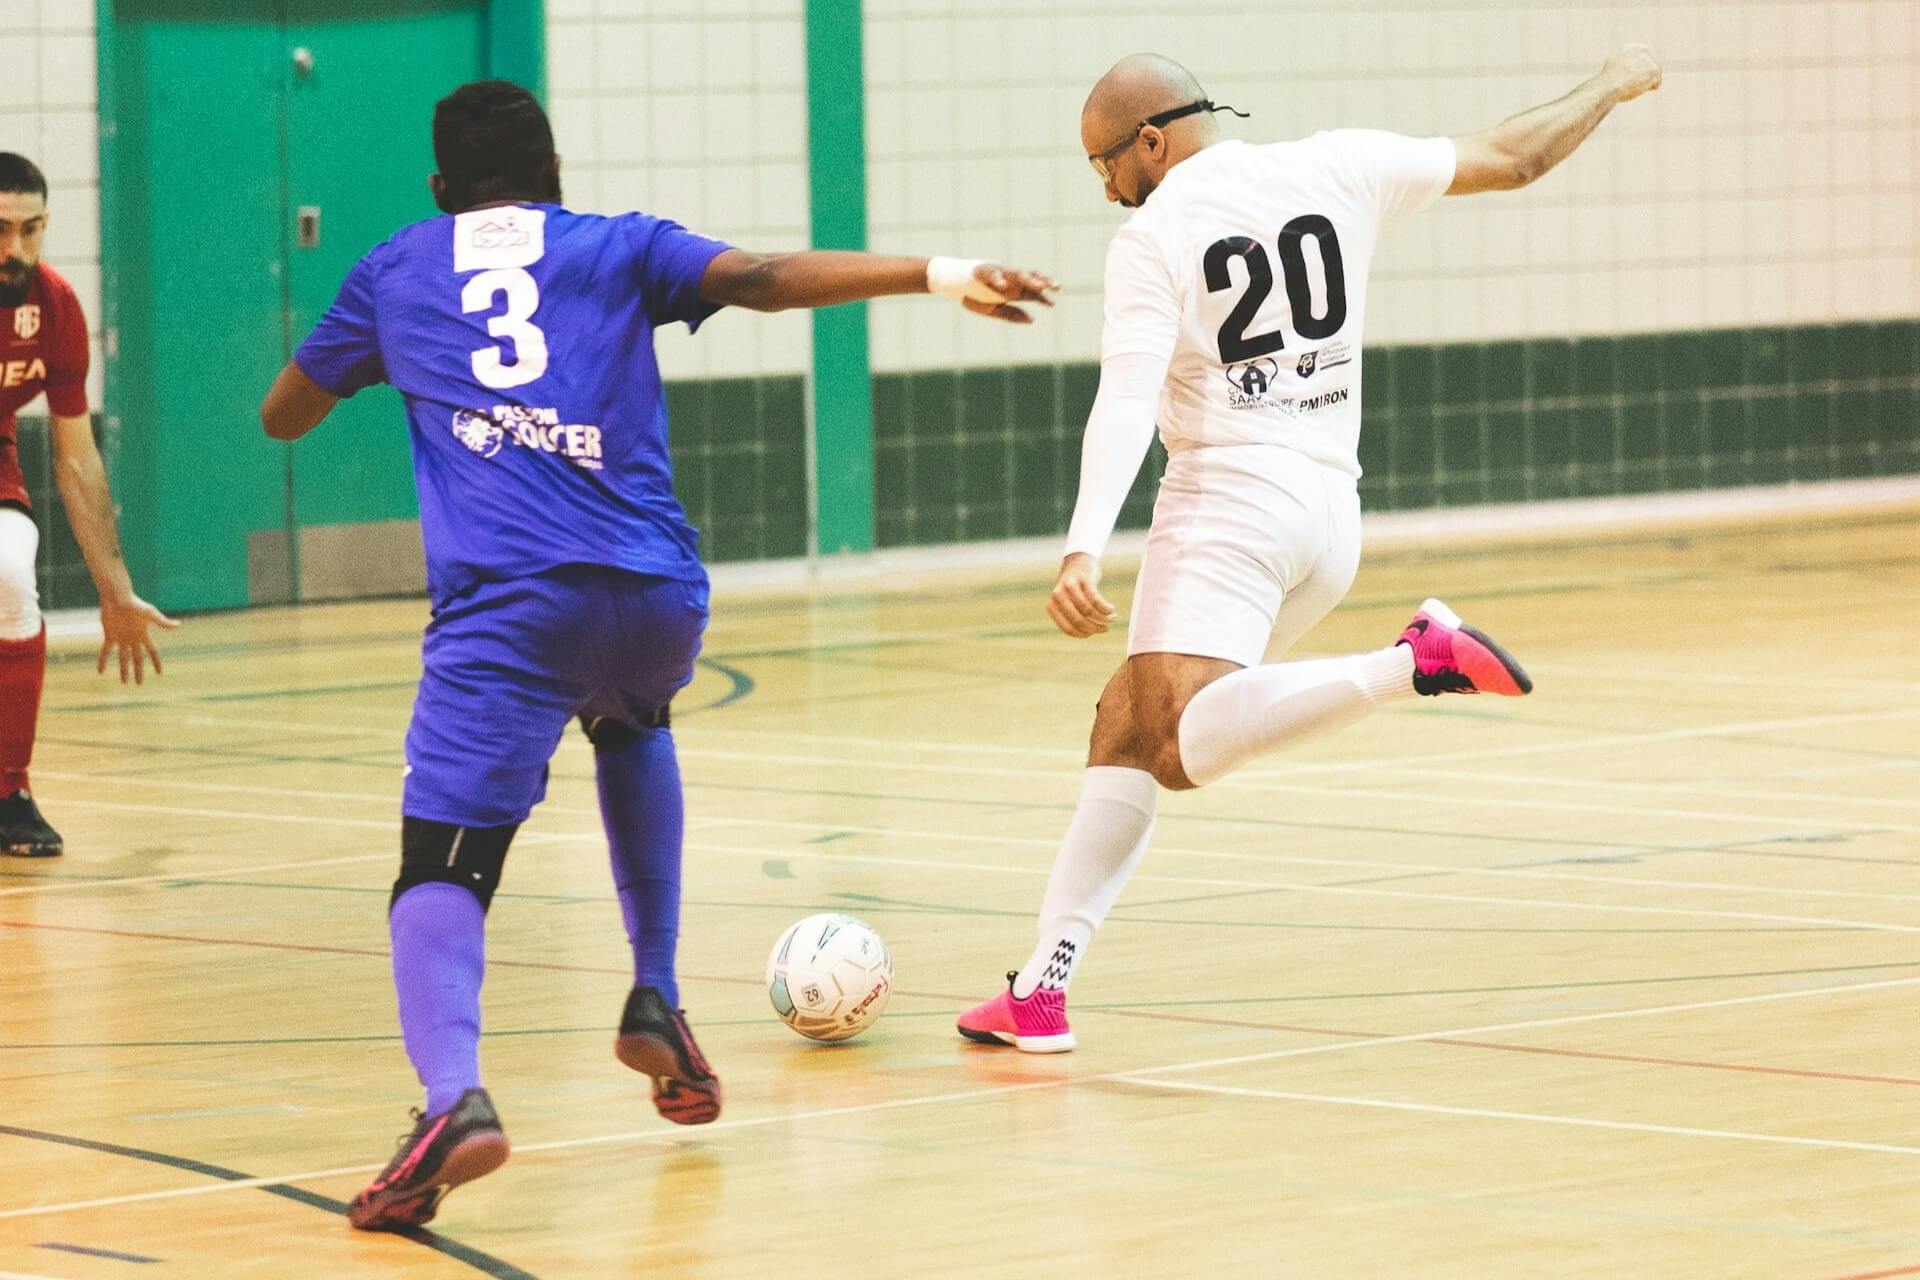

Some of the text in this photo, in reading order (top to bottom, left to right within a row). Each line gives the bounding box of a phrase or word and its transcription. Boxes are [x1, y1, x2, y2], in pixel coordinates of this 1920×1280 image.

[461, 268, 549, 389] 3
[1203, 214, 1347, 364] 20
[492, 405, 559, 424] PASSON
